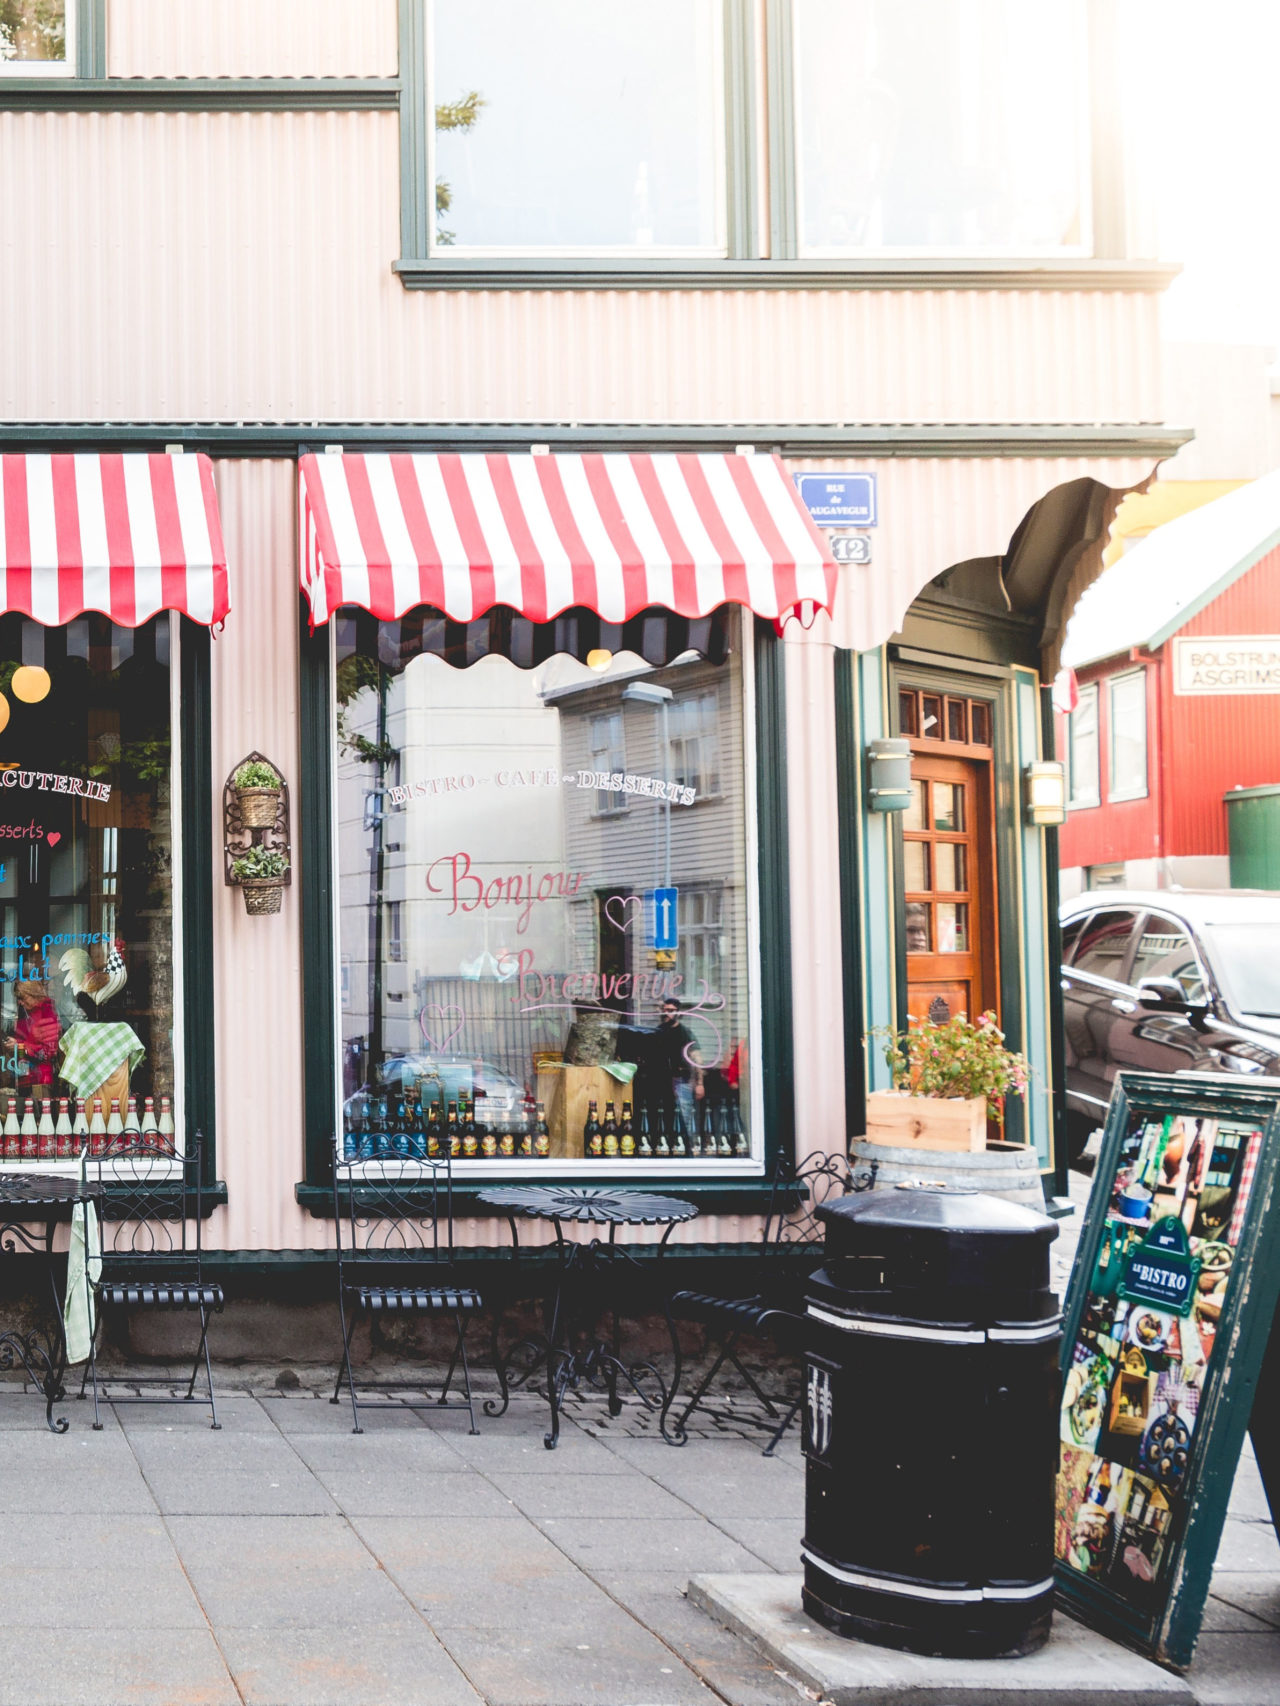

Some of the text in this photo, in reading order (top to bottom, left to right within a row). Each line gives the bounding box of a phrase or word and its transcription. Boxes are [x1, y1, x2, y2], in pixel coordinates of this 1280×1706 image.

[826, 484, 845, 493] RUE
[830, 495, 842, 504] de
[810, 506, 868, 515] AUGAVEGUR
[835, 539, 865, 560] 12
[388, 774, 475, 806] BISTRO
[577, 770, 697, 806] DESSERTS
[426, 851, 593, 935] Bonjour
[41, 931, 111, 961] pommes
[496, 948, 684, 1004] Bienvenue
[1139, 1264, 1187, 1290] BISTRO
